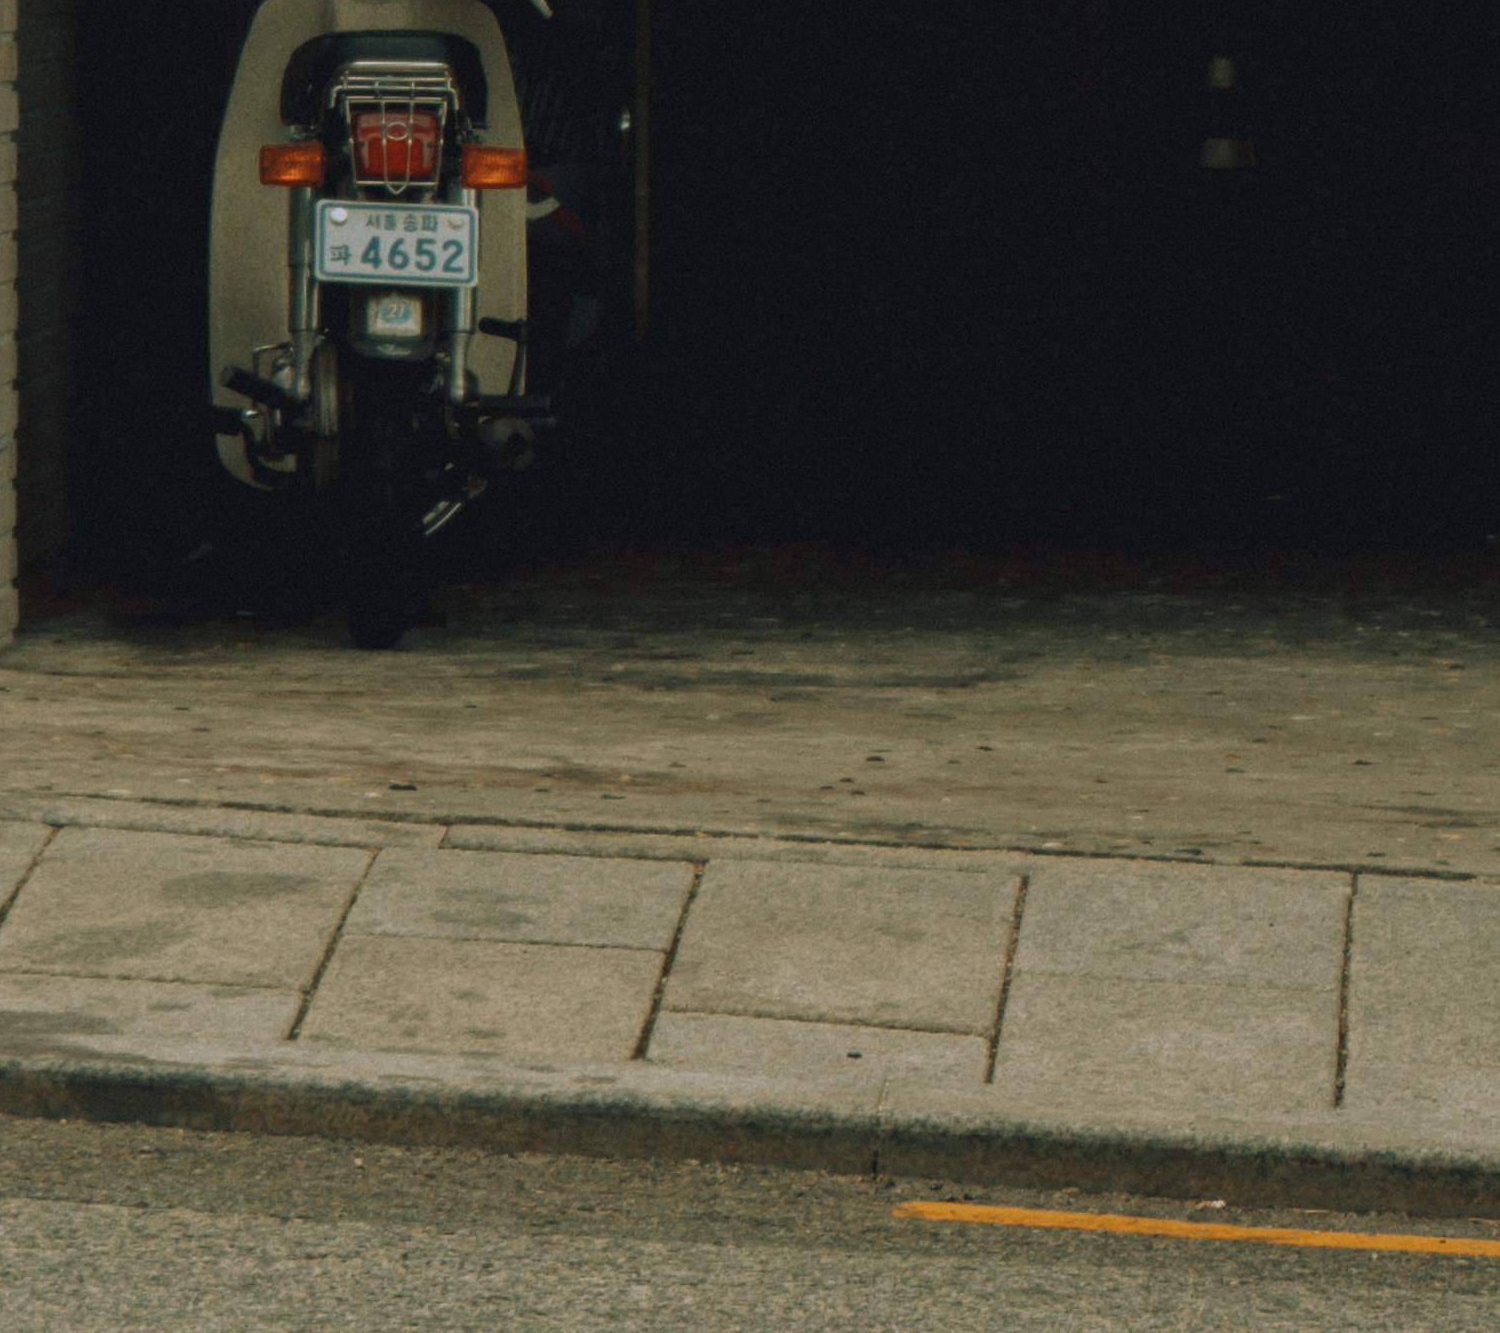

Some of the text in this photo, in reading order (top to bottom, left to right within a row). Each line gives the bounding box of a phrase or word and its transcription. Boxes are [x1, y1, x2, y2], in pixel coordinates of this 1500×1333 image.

[366, 214, 397, 231] 서울
[329, 236, 465, 274] 파 4652
